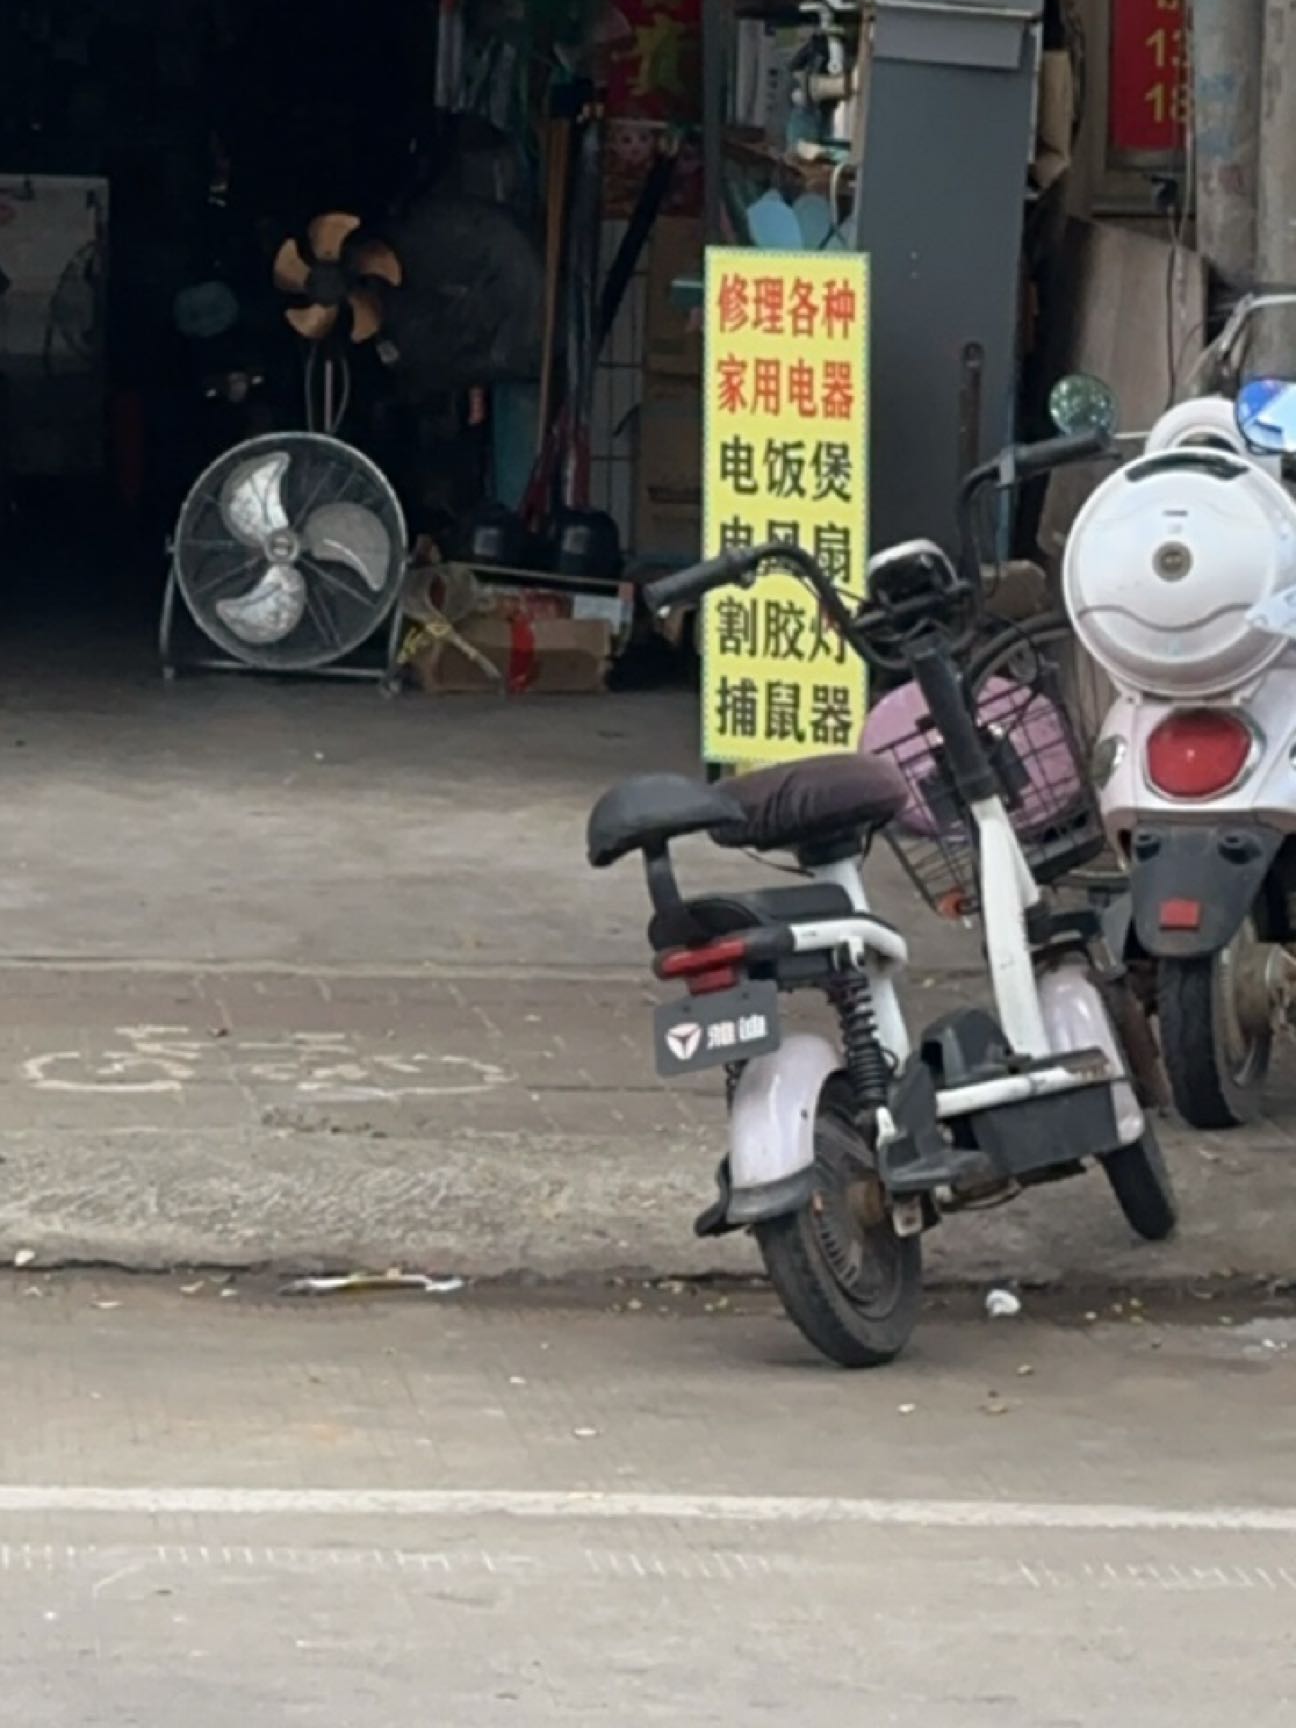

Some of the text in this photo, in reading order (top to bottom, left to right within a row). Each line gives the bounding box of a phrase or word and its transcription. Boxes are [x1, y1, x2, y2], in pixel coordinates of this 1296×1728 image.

[718, 273, 856, 339] 修理各种
[717, 353, 853, 419] 家用电器
[720, 435, 853, 502] 电饭煲
[717, 676, 853, 746] 捕鼠器
